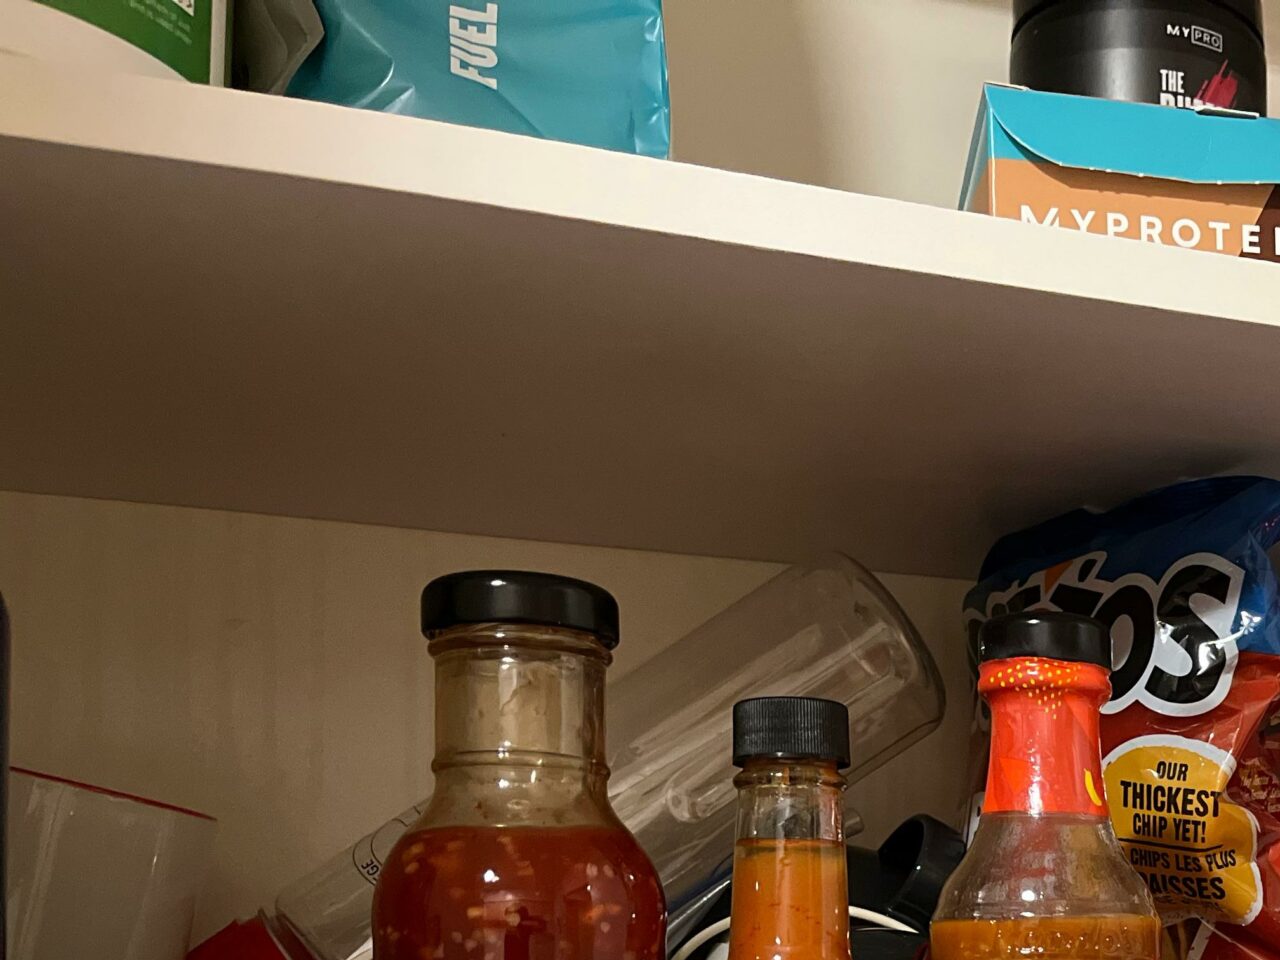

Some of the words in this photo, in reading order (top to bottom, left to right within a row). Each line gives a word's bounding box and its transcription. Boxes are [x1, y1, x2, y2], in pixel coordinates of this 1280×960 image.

[449, 3, 498, 90] FUEL
[1160, 69, 1185, 94] THE
[1156, 761, 1189, 781] OUR
[1120, 780, 1223, 818] THICKEST
[1133, 812, 1168, 838] CHIP
[1173, 818, 1206, 843] YET!
[1130, 849, 1170, 869] CHIPS
[1175, 853, 1202, 873] LES
[1205, 849, 1237, 873] PLUS
